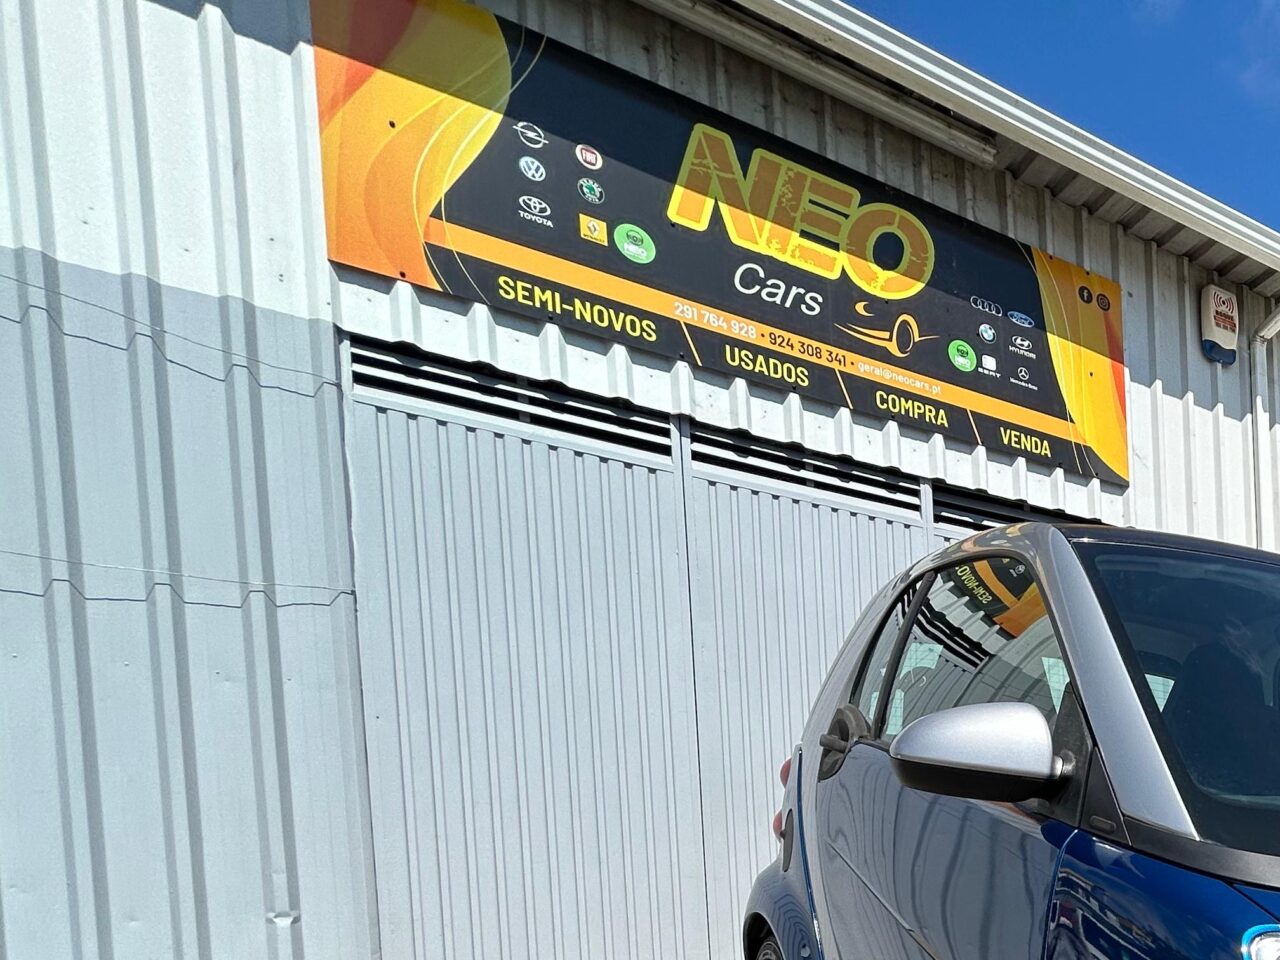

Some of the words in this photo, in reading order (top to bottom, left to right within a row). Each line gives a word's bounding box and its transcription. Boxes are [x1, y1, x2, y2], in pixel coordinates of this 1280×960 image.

[518, 210, 554, 228] TOYOTA
[667, 123, 935, 300] NEO
[499, 276, 657, 342] SEMI-NOVOS
[734, 263, 824, 316] Cars
[674, 302, 698, 321] 291
[701, 310, 728, 330] 764
[730, 319, 757, 339] 928
[769, 332, 794, 351] 924
[798, 341, 822, 359] 308
[826, 350, 847, 367] 341
[857, 362, 942, 395] geral@neocars.pt
[725, 344, 809, 388] USADOS
[876, 391, 949, 429] COMPRA
[1000, 427, 1052, 459] VENDA
